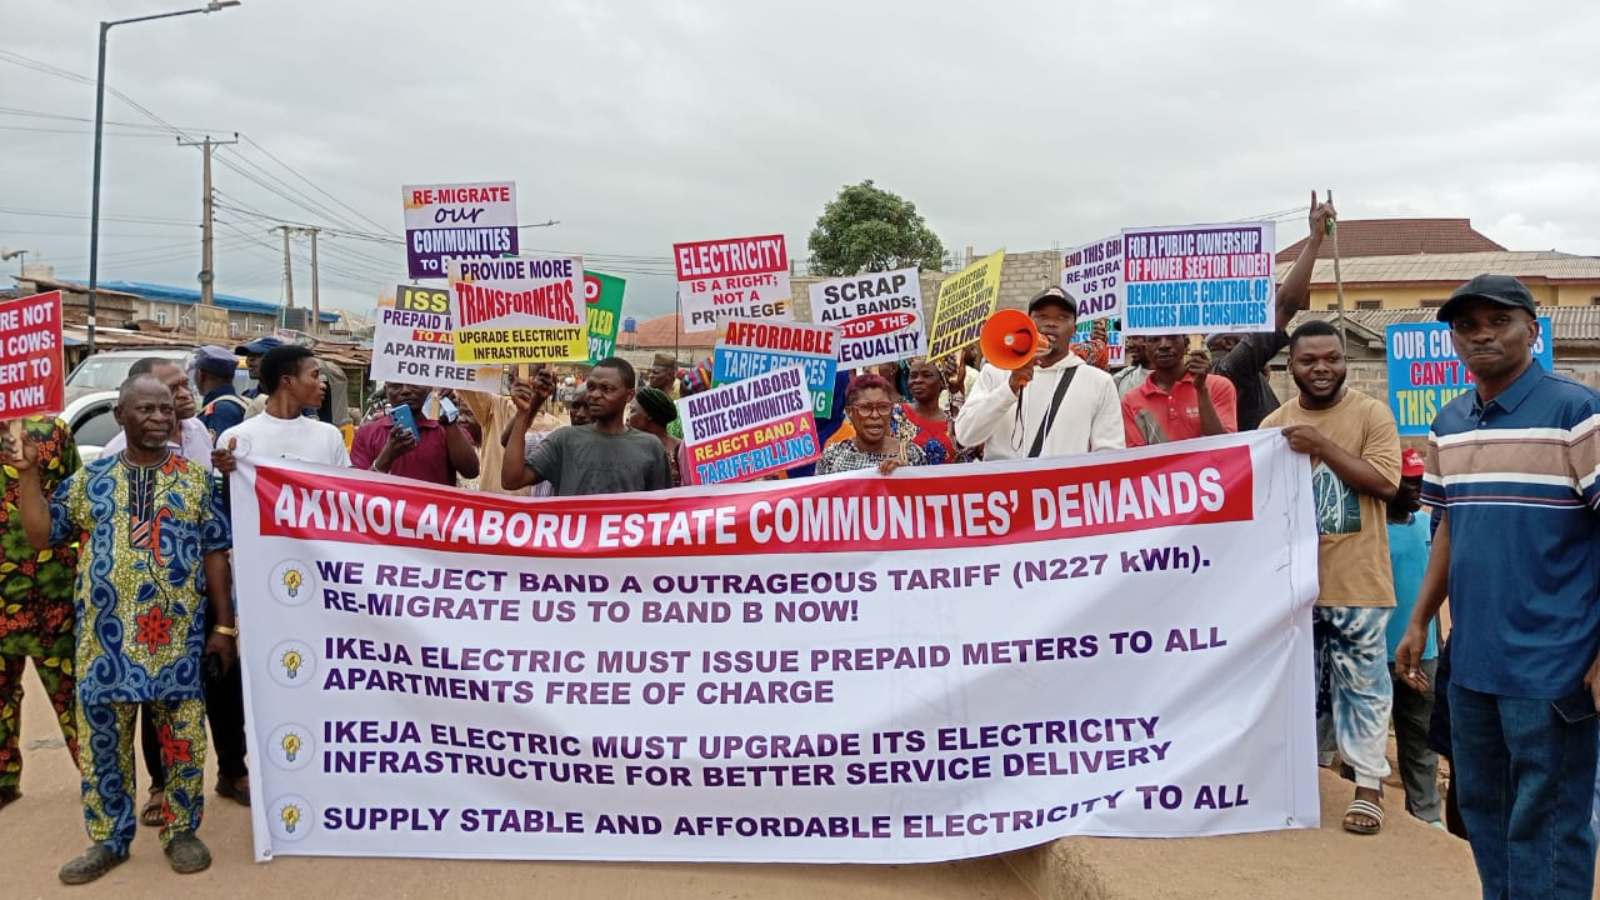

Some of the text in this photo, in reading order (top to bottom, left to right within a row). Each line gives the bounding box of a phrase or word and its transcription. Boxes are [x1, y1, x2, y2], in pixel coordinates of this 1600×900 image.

[412, 187, 511, 205] RE-MIGRATE
[434, 207, 485, 223] our
[413, 228, 511, 254] COMMUNITIES
[1128, 231, 1259, 258] FOR A PUBLIC OWNERSHIP
[420, 259, 438, 270] TO
[680, 239, 781, 276] ELECTRICITY
[1065, 252, 1081, 268] END
[1083, 243, 1104, 264] THIS
[1128, 253, 1268, 281] OF POWER SECTOR UNDER
[460, 261, 526, 281] PROVIDE
[530, 259, 573, 279] MORE
[691, 274, 778, 293] IS A RIGHT;
[1067, 260, 1121, 284] RE-MIGRA
[713, 290, 760, 305] NOT A
[824, 274, 906, 304] SCRAP
[1083, 276, 1116, 294] US TO
[1127, 279, 1268, 306] DEMOCRATIC CONTROL OF
[23, 302, 54, 327] NOT
[455, 279, 579, 327] TRANSFORMERS.
[691, 302, 785, 325] PRIVILEGE
[821, 295, 917, 322] ALL BANDS;
[1127, 305, 1177, 328] WORKERS
[1179, 305, 1199, 326] AND
[1202, 302, 1266, 325] CONSUMERS
[383, 310, 441, 330] PREPAID
[840, 314, 909, 336] STOP THE
[934, 300, 991, 340] OUTRAGEOUS
[8, 330, 55, 356] COWS:
[417, 330, 435, 341] TO
[459, 328, 581, 344] UPGRADE ELECTRICITY
[725, 322, 833, 354] AFFORDABLE
[1393, 331, 1425, 360] OUR
[474, 346, 569, 360] INFRASTRUCTURE
[724, 351, 768, 378] TARIFF
[30, 357, 52, 379] TO
[397, 361, 476, 381] FOR FREE
[1410, 360, 1460, 386] CAN'T
[10, 384, 45, 410] KWH
[688, 368, 800, 418] AKINOLA/ABORU
[692, 411, 728, 440] ESTATE
[728, 389, 803, 430] COMMUNITIES
[1396, 389, 1437, 426] THIS
[694, 417, 810, 462] REJECT BAND A
[696, 434, 815, 485] TARIFF/BILLING
[274, 483, 587, 549] AKINOLA/ABORU
[597, 506, 737, 548] ESTATE
[1032, 467, 1225, 532] DEMANDS
[315, 545, 1211, 594] WE REJECT BAND A OUTRAGEOUS TARIFF (N227 kWh).
[323, 588, 859, 623] RE-MIGRATE US TO BAND B NOW!
[325, 627, 1227, 673] IKEJA ELECTRIC MUST ISSUE PREPAID METERS TO ALL
[323, 668, 834, 705] APARTMENTS FREE OF CHARGE
[323, 716, 1160, 760] IKEJA ELECTRIC MUST UPGRADE ITS ELECTRICITY
[323, 741, 1172, 787] INFRASTRUCTURE FOR BETTER SERVICE DELIVERY
[323, 784, 1249, 839] SUPPLY STABLE AND AFFORDABLE ELECTRICITY TO ALL
